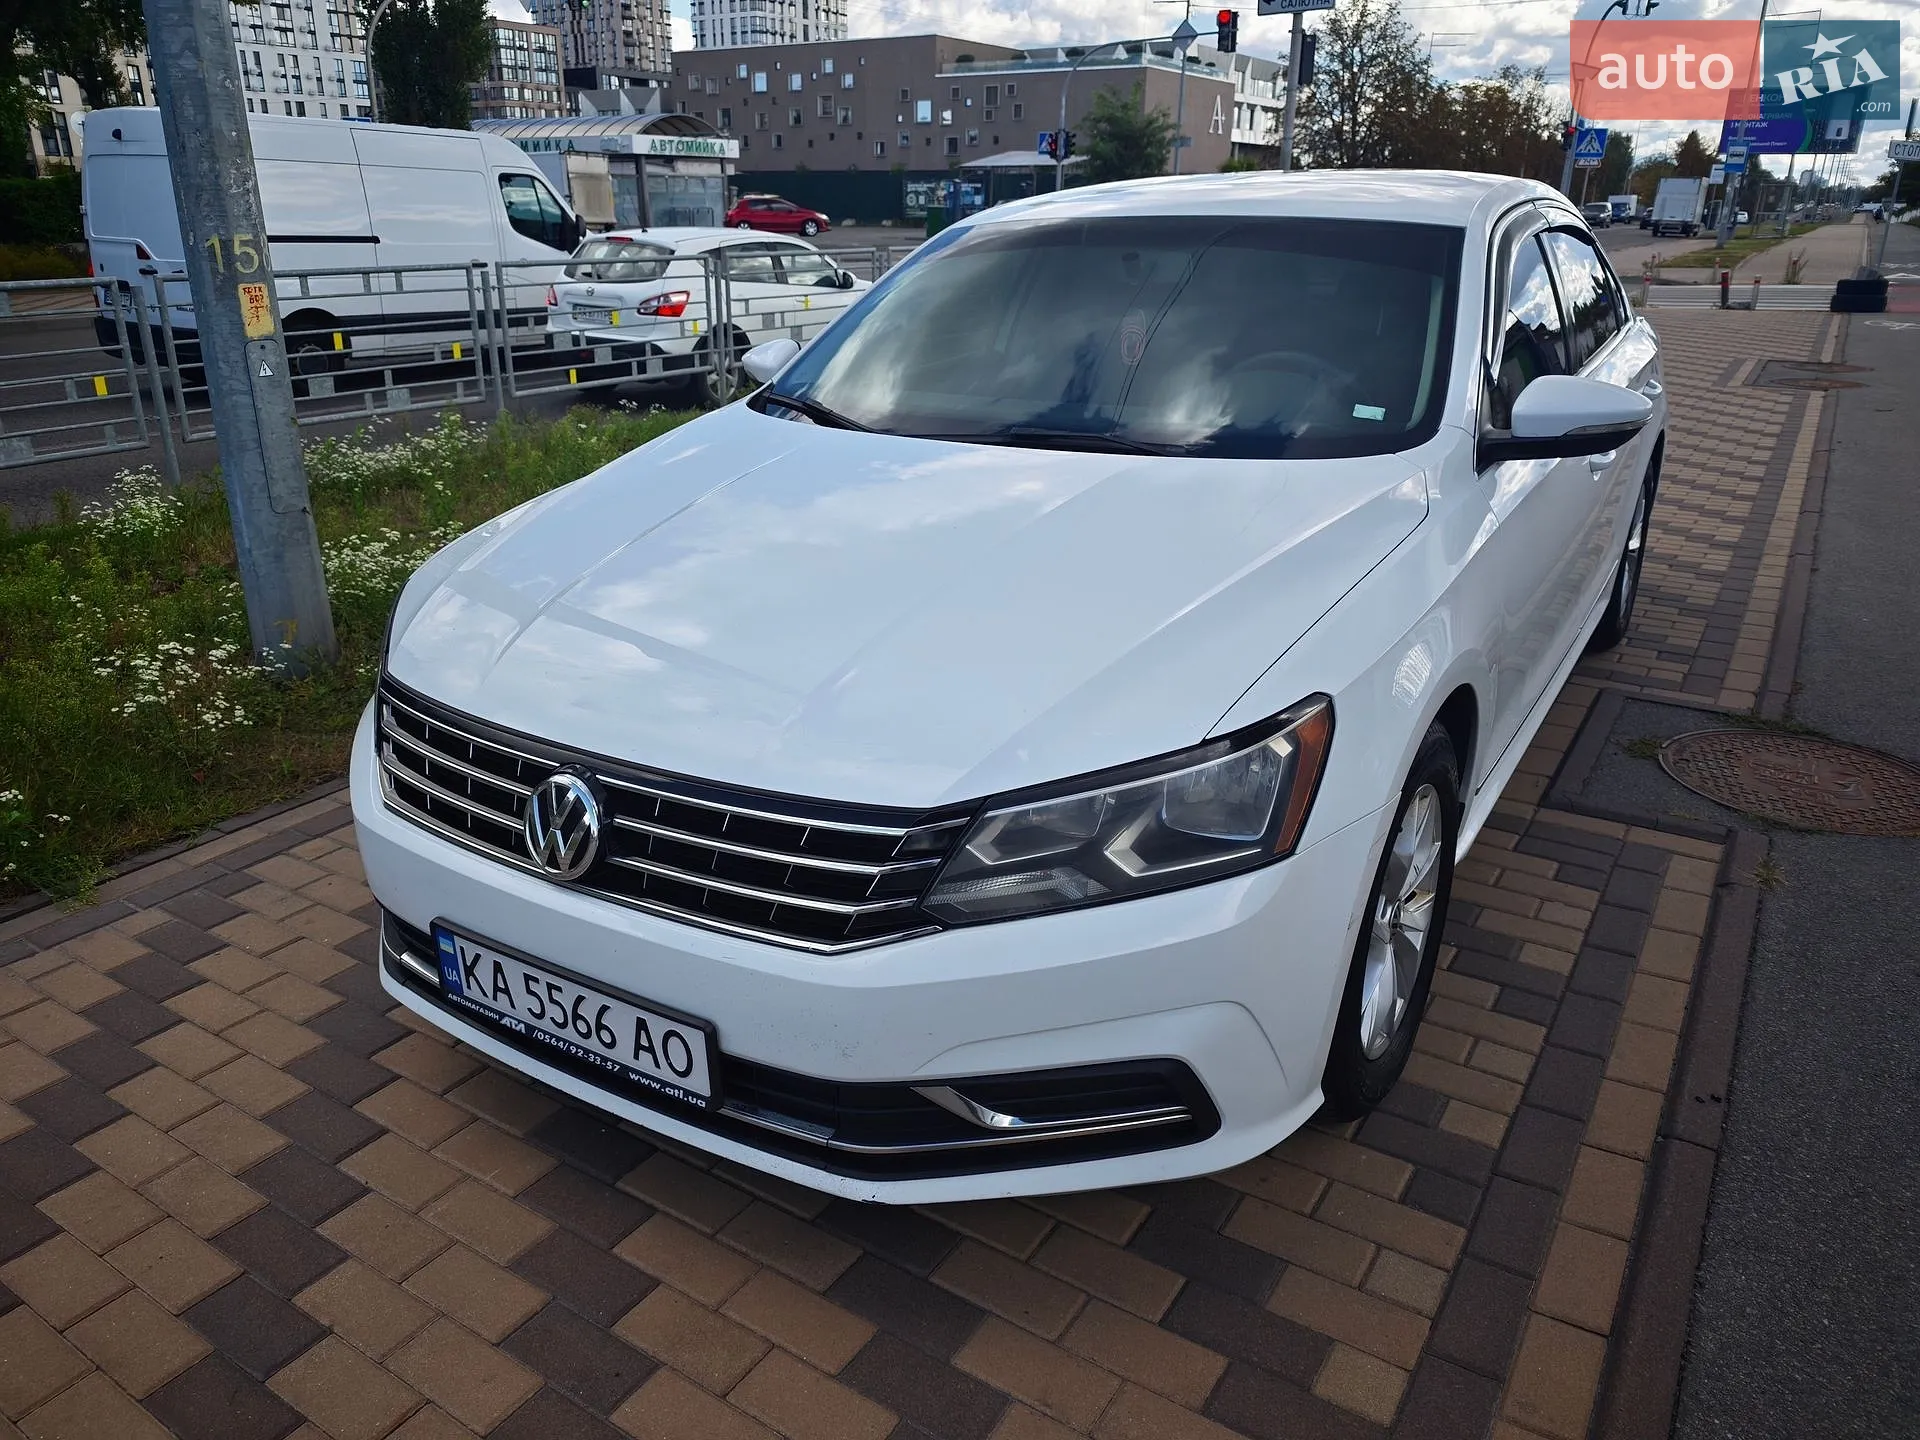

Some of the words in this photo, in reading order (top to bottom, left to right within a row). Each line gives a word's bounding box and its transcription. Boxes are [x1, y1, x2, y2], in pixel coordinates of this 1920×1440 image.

[650, 138, 726, 156] АВТОМИЙКА
[443, 966, 460, 986] UA
[460, 945, 517, 1010] KA
[523, 971, 617, 1050] 5566
[633, 1015, 693, 1079] AO
[448, 993, 499, 1020] АВТОМАГАЗИН
[570, 1045, 621, 1072] 92-33-57
[628, 1071, 707, 1108] www.atl.ua
